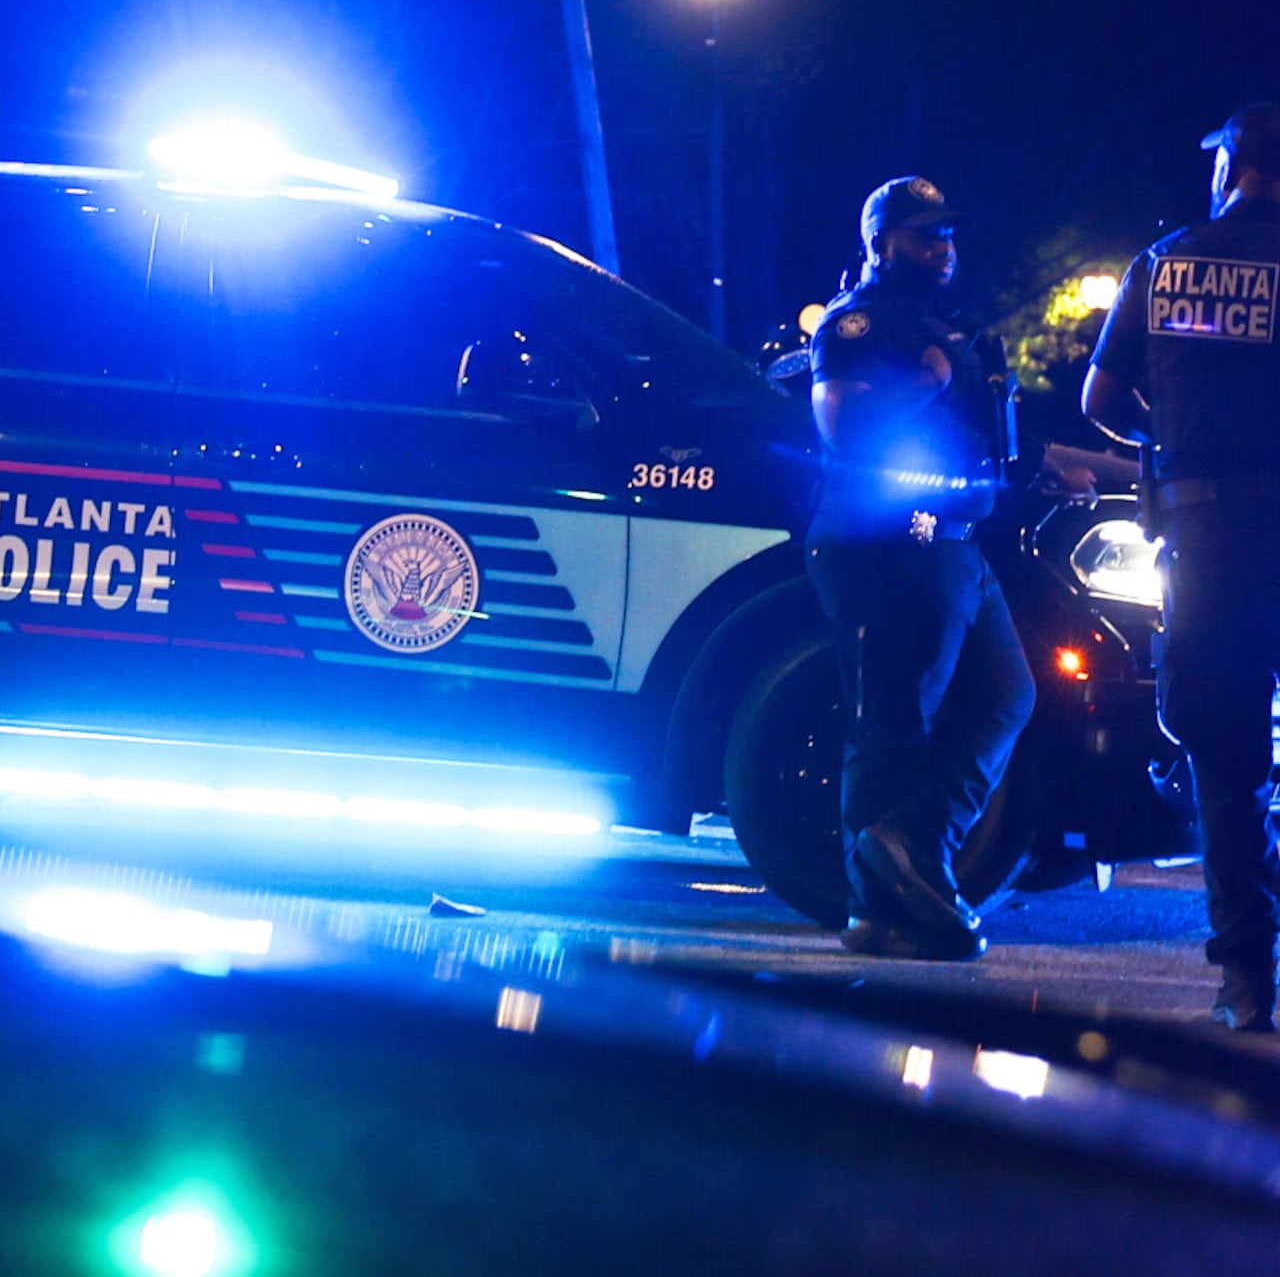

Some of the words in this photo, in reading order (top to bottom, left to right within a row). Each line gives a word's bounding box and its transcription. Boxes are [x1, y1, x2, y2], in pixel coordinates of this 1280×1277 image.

[1154, 261, 1269, 300] ATLANTA
[1152, 297, 1269, 337] POLICE
[631, 463, 715, 491] 36148
